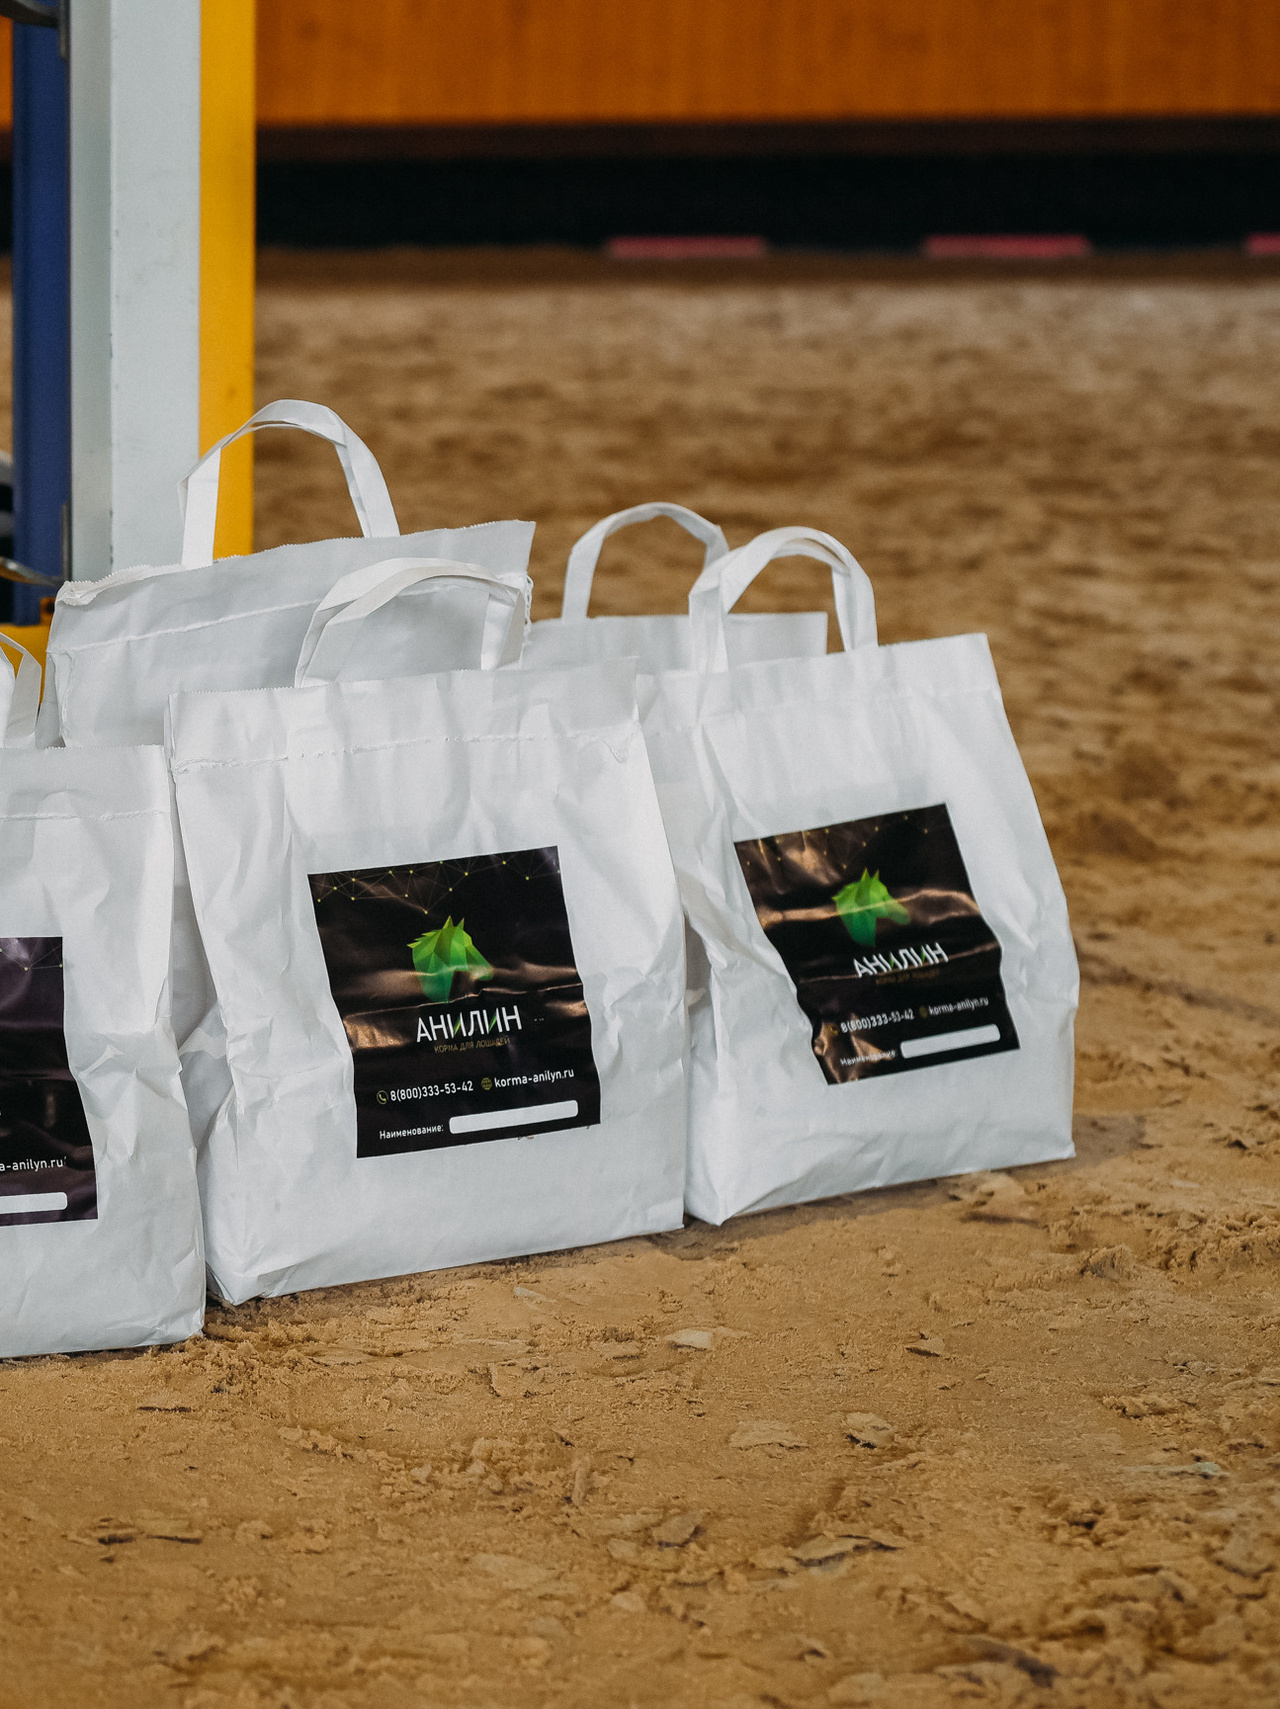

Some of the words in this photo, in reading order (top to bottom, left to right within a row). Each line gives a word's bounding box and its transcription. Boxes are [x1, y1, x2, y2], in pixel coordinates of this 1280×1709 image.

[853, 942, 949, 978] АНИЛИН
[416, 1005, 522, 1043] АНИЛИН
[840, 1008, 915, 1033] 8(800)333-53-42
[928, 997, 989, 1016] korma-anilyn.ru
[434, 1043, 458, 1053] КОРМА
[460, 1041, 474, 1051] ДЛЯ
[475, 1035, 510, 1048] ЛОШАДЕЙ
[389, 1080, 474, 1102] 8(800)333-53-42
[493, 1068, 575, 1088] korma-anilyn.ru
[379, 1123, 444, 1140] Наименование:
